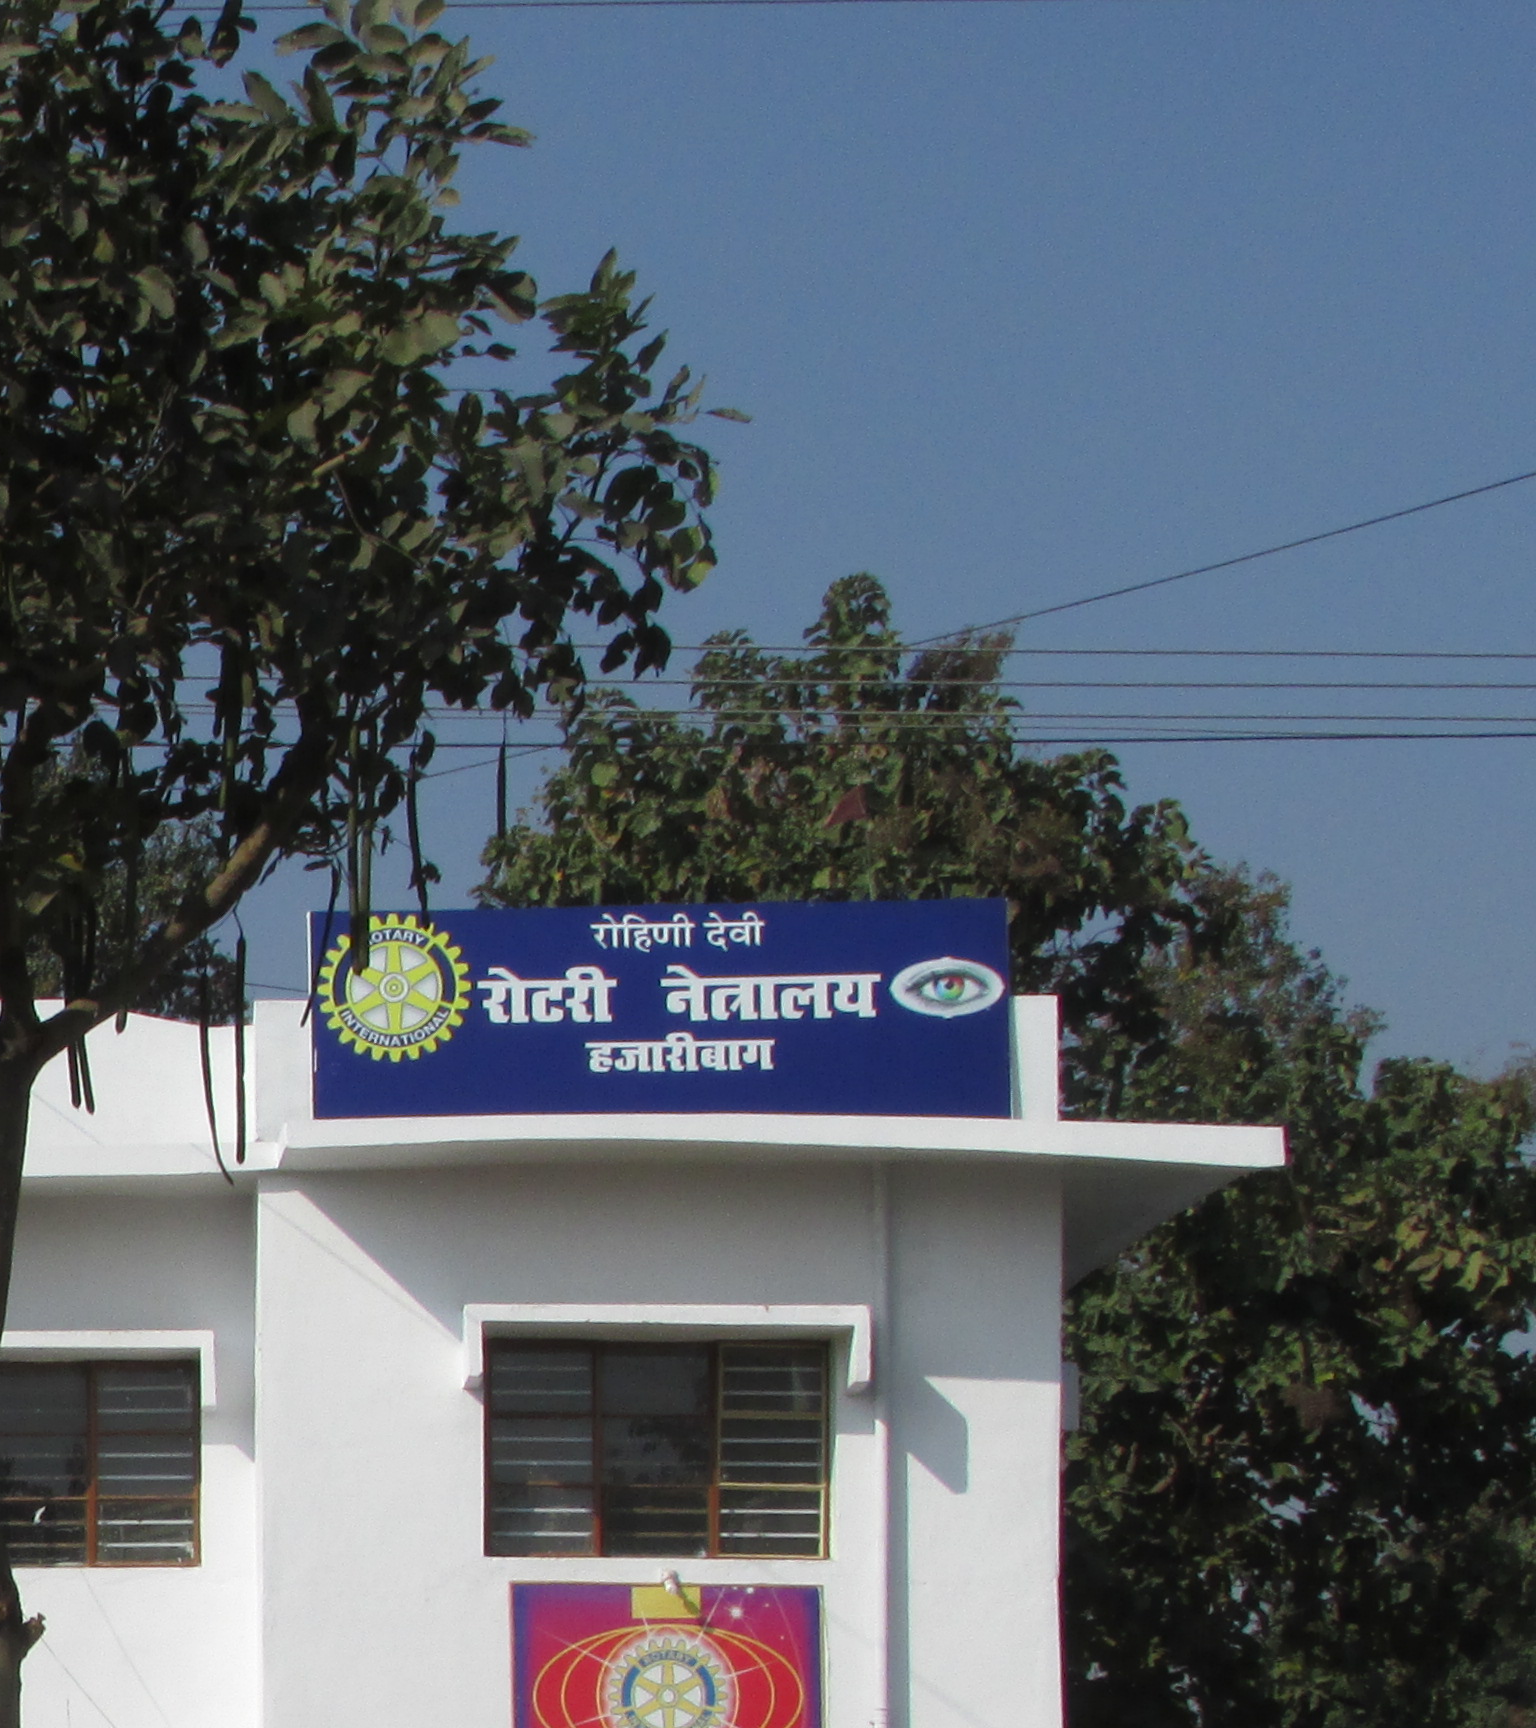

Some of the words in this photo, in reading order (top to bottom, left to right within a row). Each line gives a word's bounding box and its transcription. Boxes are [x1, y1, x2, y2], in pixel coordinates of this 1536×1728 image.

[366, 928, 426, 946] OTARY
[590, 912, 695, 952] रोहिणी
[703, 911, 765, 951] देवी
[477, 965, 617, 1023] रोटरी
[660, 964, 882, 1022] नेत्रालय
[340, 1007, 450, 1047] INTERNATIONAL
[584, 1031, 775, 1073] हजारीबाग
